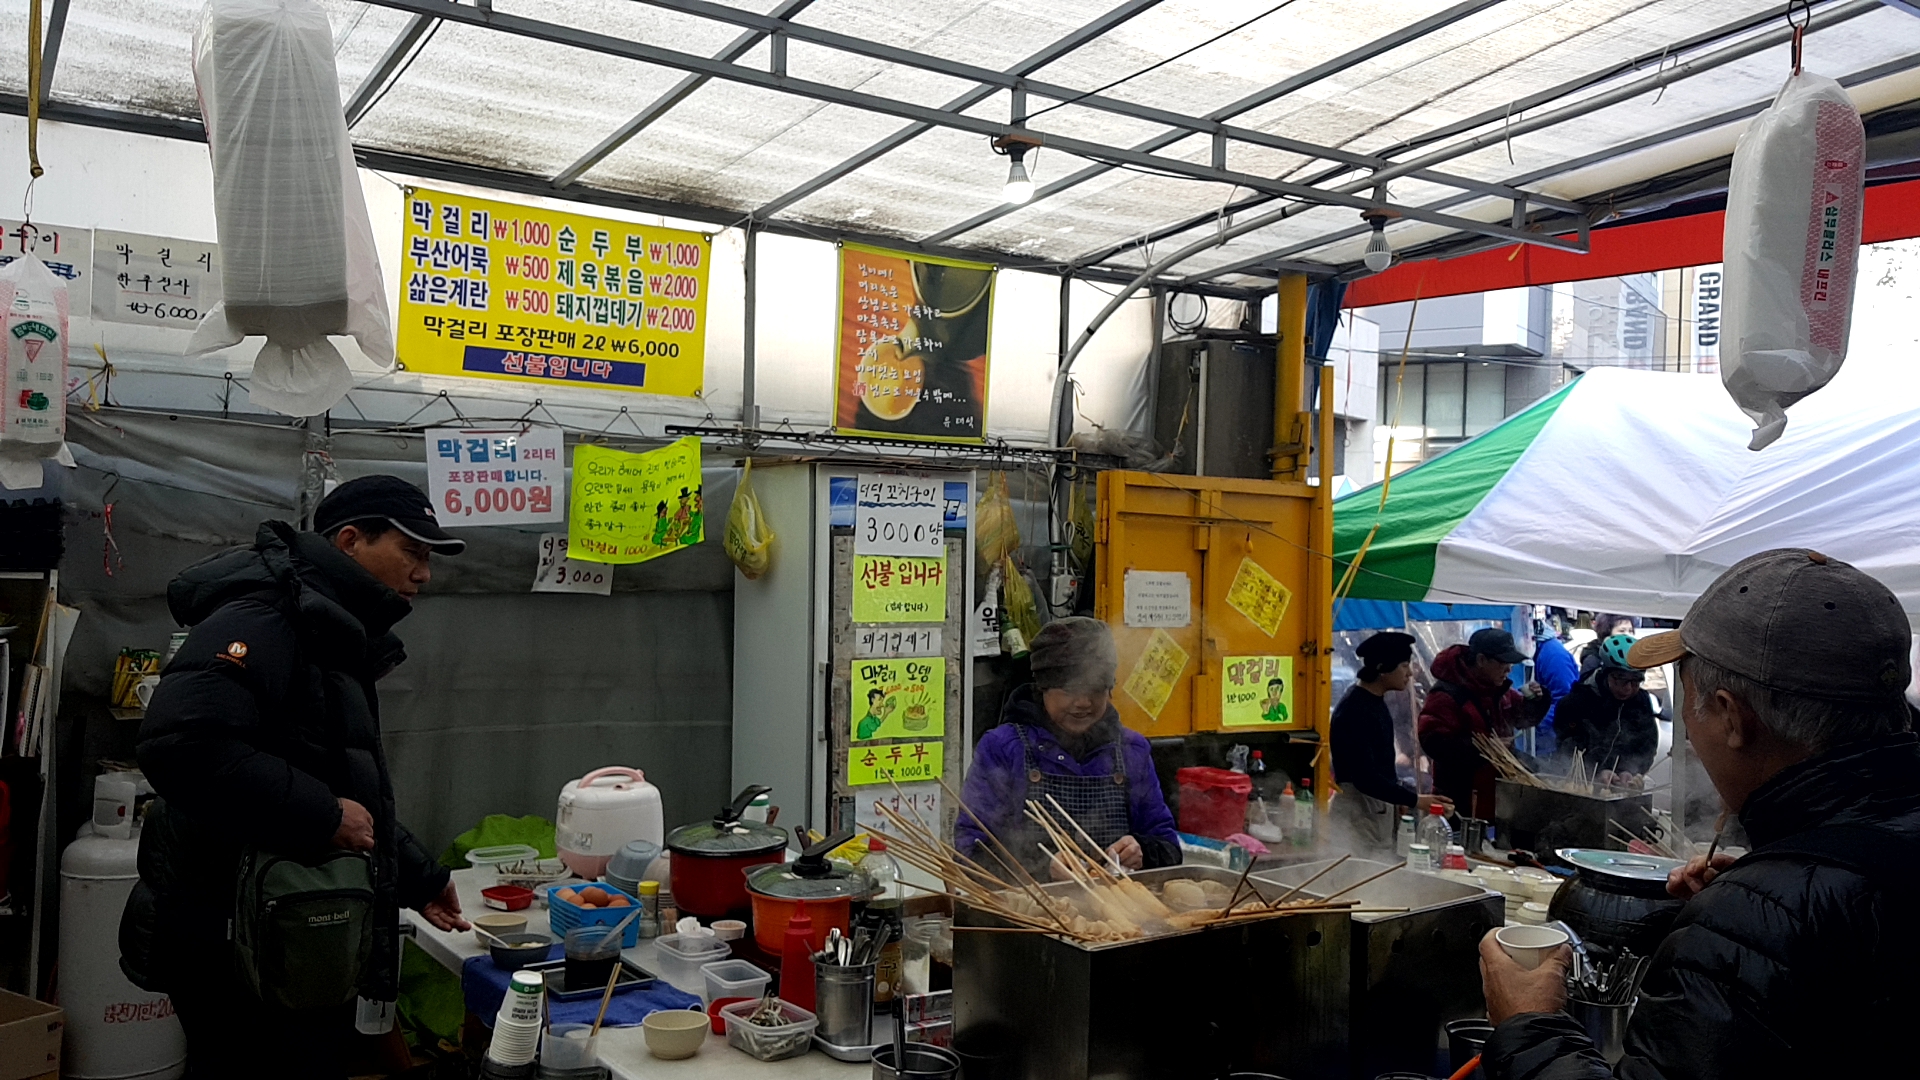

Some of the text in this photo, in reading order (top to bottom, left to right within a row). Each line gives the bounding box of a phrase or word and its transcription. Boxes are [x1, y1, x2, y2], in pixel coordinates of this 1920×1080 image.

[410, 236, 489, 275] 부산어묵
[409, 272, 489, 309] 삶은계란
[556, 293, 643, 328] 돼지껍데기
[1698, 272, 1722, 346] GRAND
[423, 315, 488, 340] 막걸리
[495, 323, 576, 349] 포장판매
[501, 351, 613, 379] 선불입니다
[437, 438, 556, 463] 막걸리 2리터
[444, 485, 552, 516] 6,000원
[861, 662, 931, 685] 막걸리 오뎅
